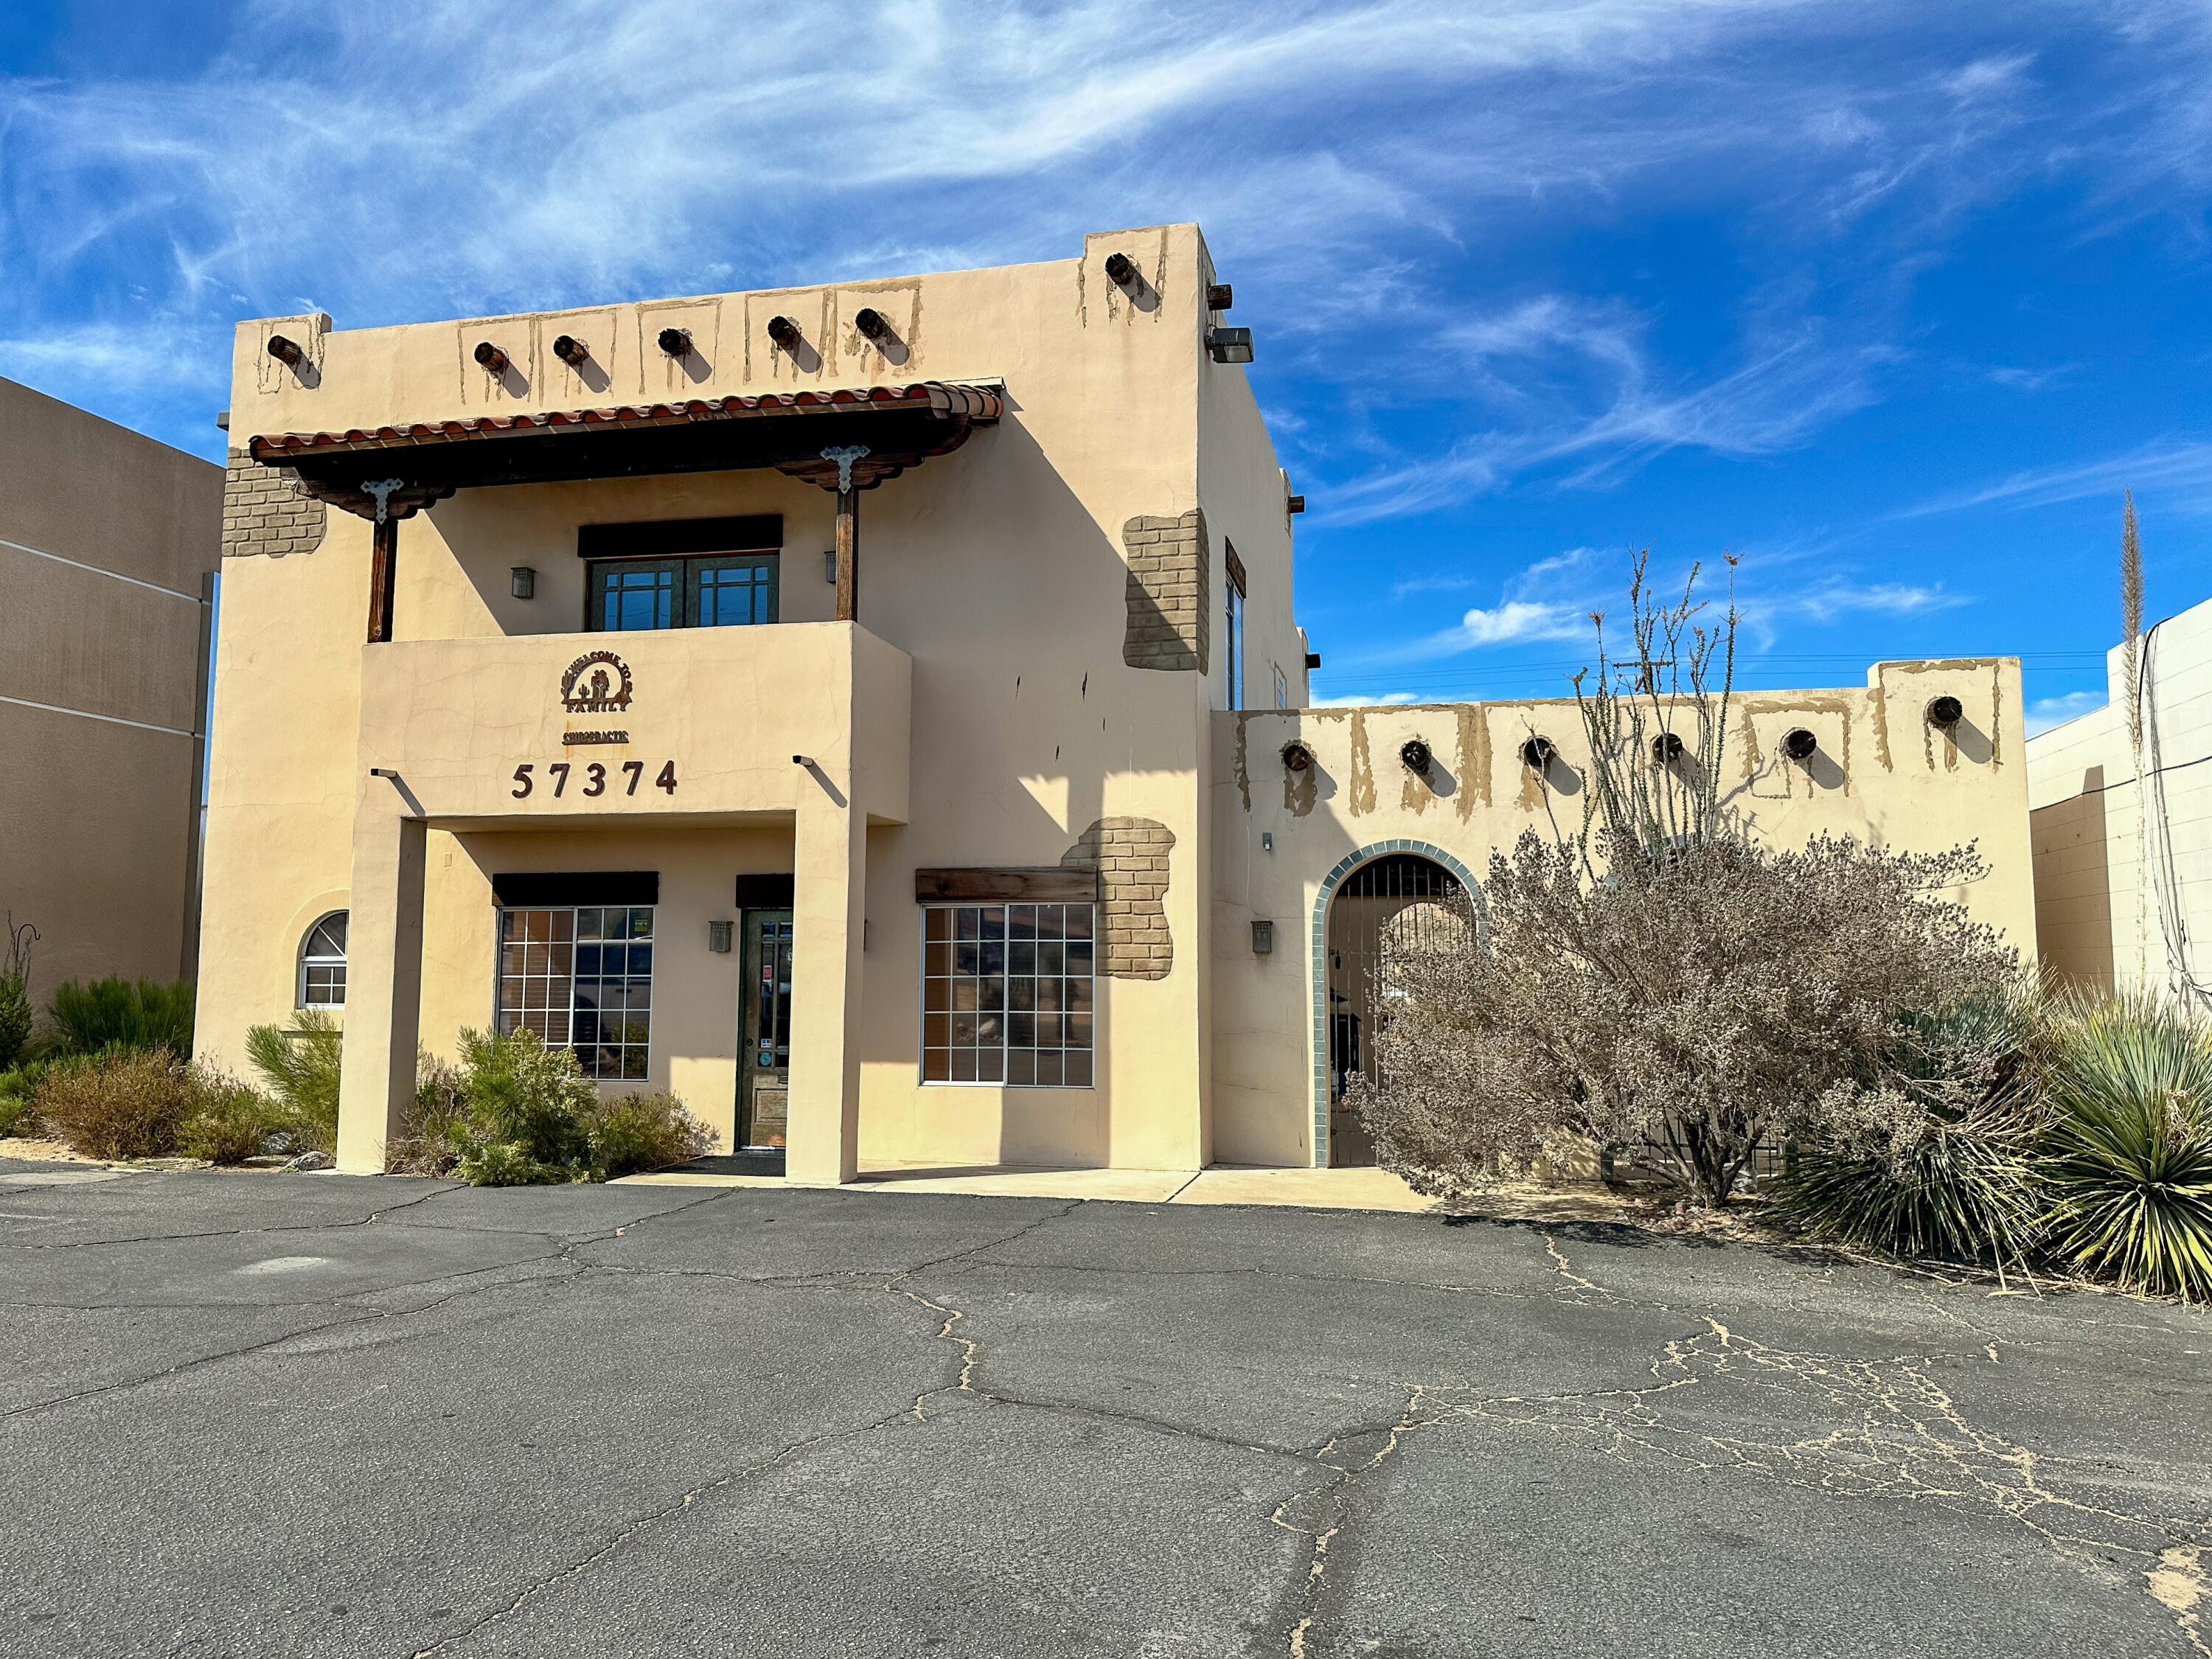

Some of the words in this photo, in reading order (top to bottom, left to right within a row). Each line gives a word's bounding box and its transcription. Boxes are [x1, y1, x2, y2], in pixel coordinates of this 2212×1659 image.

[568, 651, 622, 673] WELCOME
[622, 662, 632, 679] TO
[566, 700, 629, 713] FAMILY
[563, 730, 629, 742] CHIROPRACTIC
[511, 760, 678, 799] 57374
